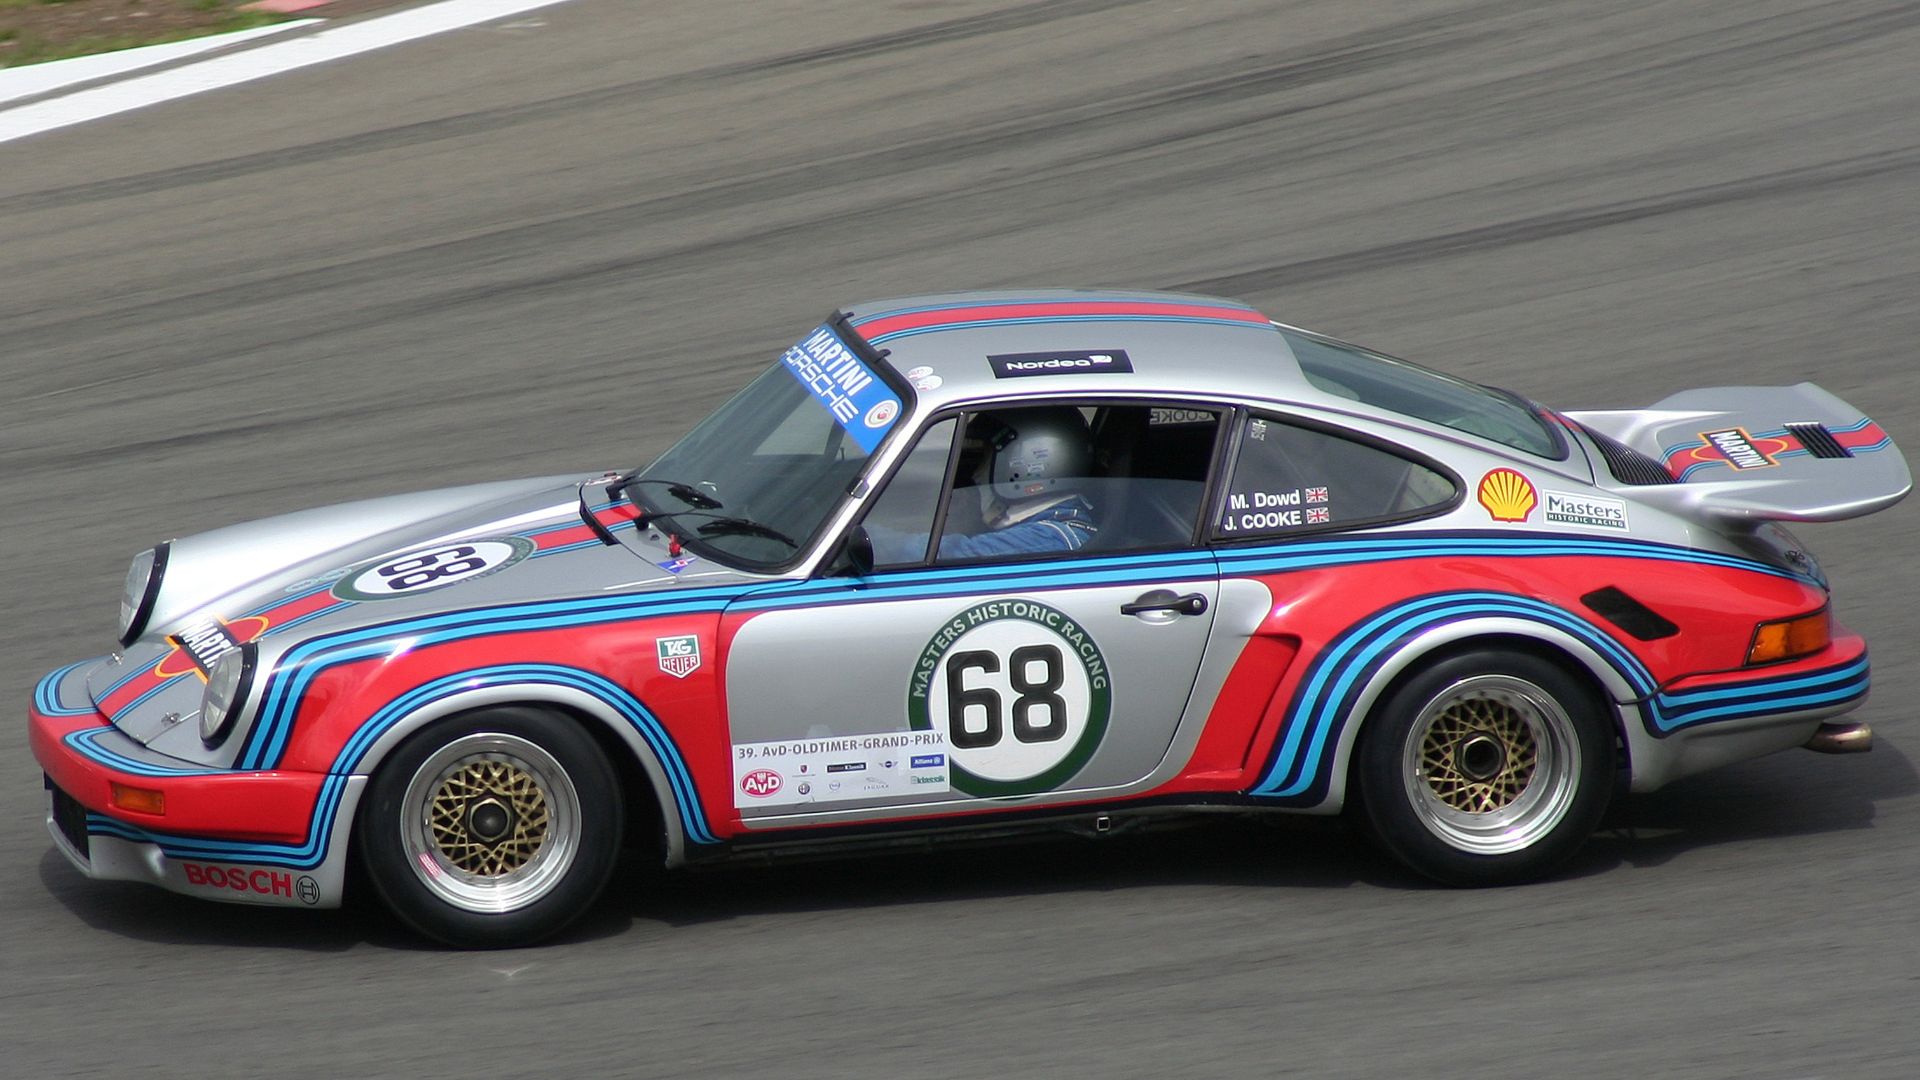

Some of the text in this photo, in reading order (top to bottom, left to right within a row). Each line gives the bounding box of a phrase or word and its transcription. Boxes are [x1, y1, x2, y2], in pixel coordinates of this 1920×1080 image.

[803, 329, 873, 397] MARTINI
[1006, 358, 1090, 371] Nordea
[1709, 431, 1768, 468] MARTINI
[1230, 489, 1300, 510] M. Dowd
[1548, 495, 1622, 519] Masters
[1224, 510, 1302, 531] J. COOKE
[1548, 513, 1625, 528] HISTORIC RACING
[377, 546, 487, 590] 68
[664, 640, 692, 655] TAG
[913, 602, 1107, 698] MASTERS HISTORIC RACING
[663, 656, 697, 674] HEUER
[946, 644, 1068, 750] 68
[739, 733, 944, 759] 39. AvD-OLDTIMER-GRAND-PRIX
[183, 863, 292, 898] BOSCH
